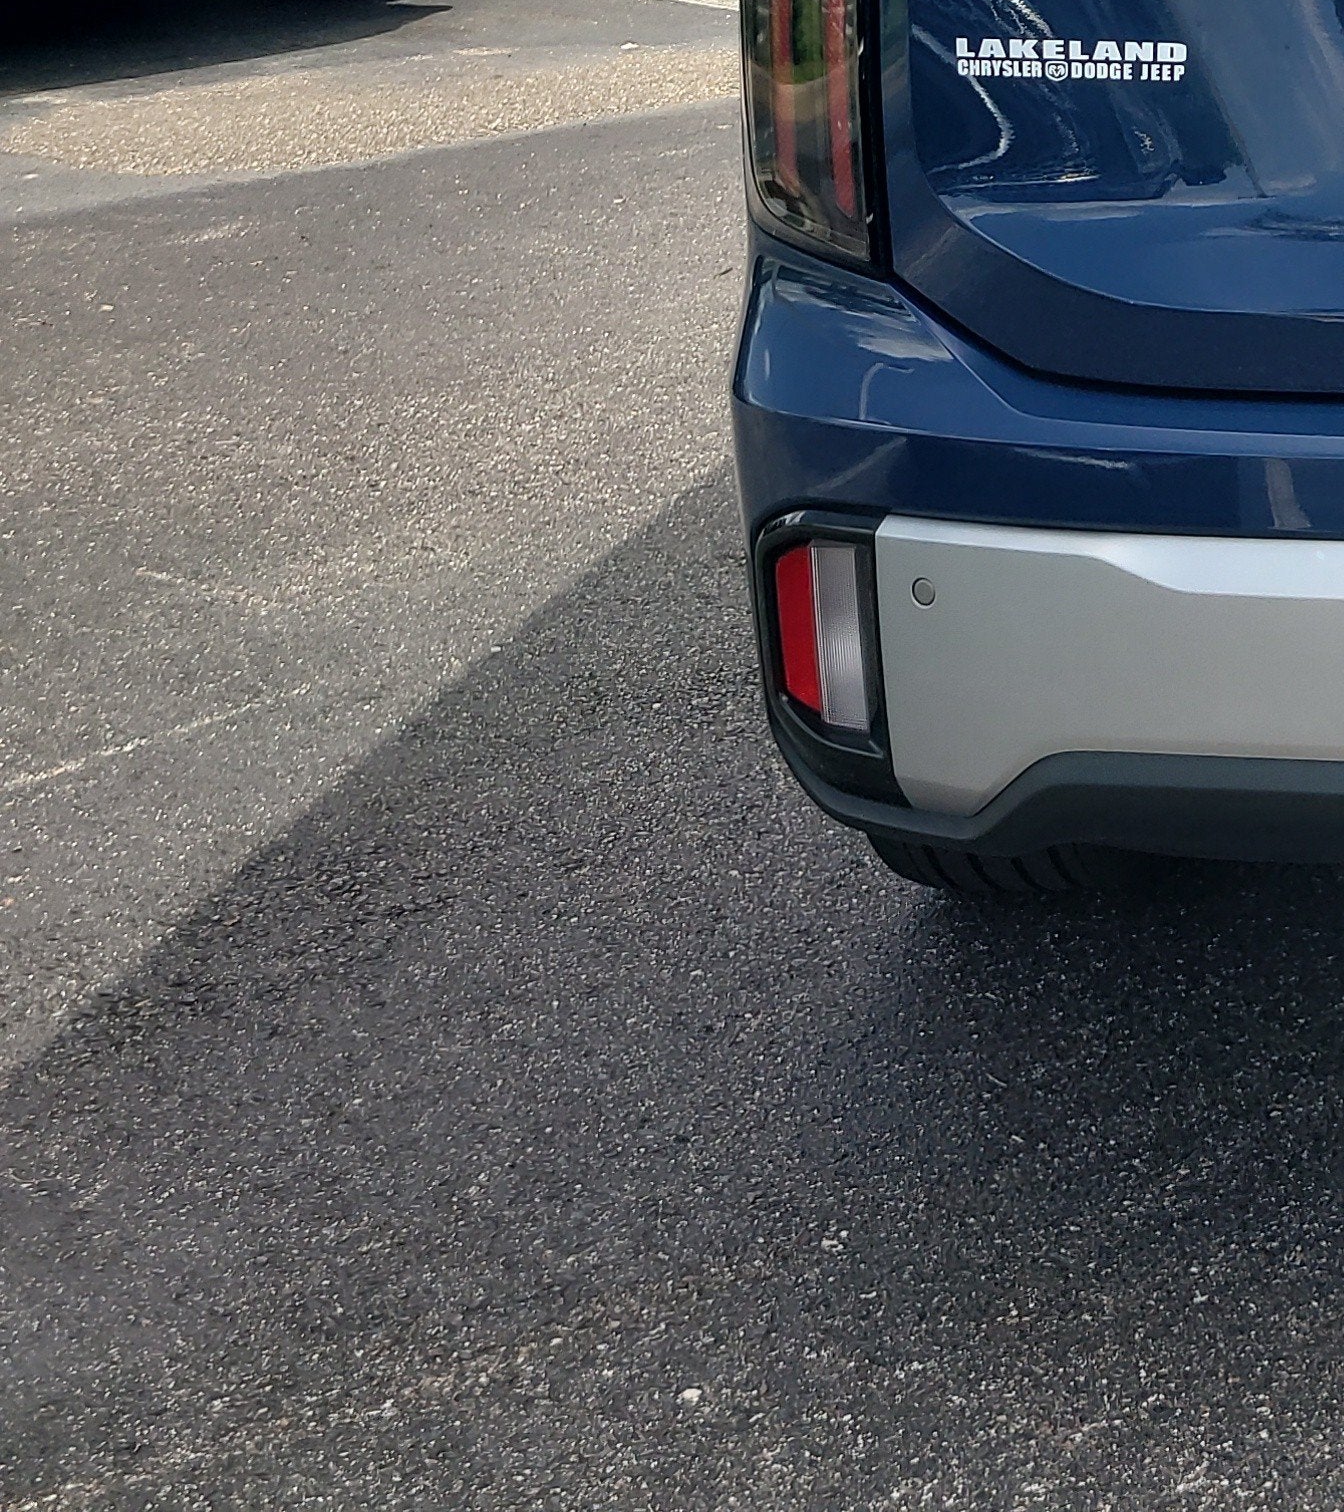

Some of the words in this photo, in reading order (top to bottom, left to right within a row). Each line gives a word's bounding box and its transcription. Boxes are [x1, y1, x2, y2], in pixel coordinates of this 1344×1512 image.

[955, 37, 1188, 63] LAKELAND
[957, 58, 1043, 77] CHRYSLER
[1070, 62, 1133, 80] DODGE
[1140, 63, 1186, 81] JEEP
